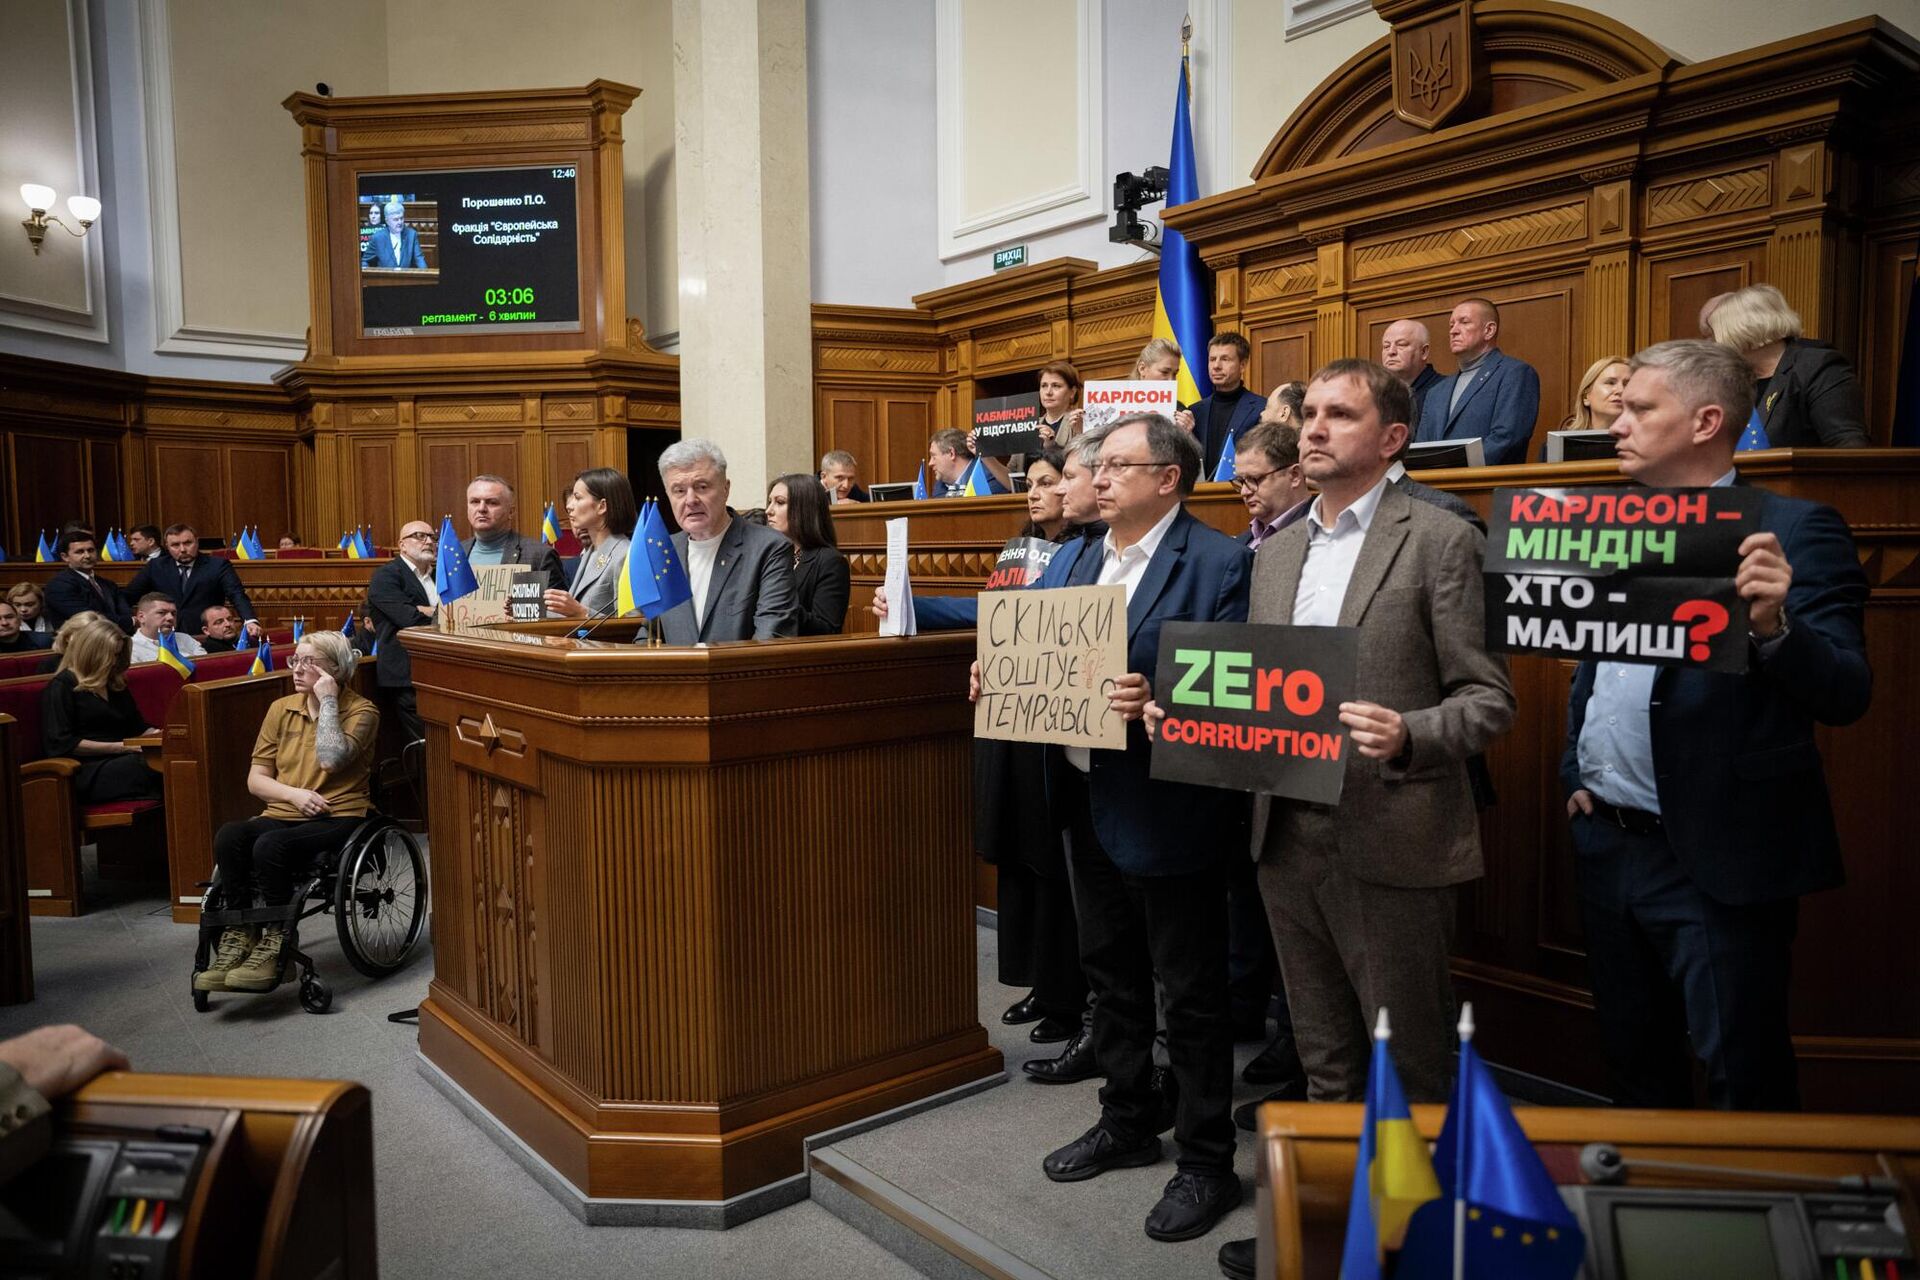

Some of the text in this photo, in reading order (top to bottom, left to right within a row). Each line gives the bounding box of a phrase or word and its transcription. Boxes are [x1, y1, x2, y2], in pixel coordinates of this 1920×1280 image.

[551, 168, 576, 179] 12:40
[461, 194, 547, 209] Порошенко П.О.
[451, 222, 489, 235] Фракція
[473, 232, 541, 246] Солідарність"
[997, 248, 1022, 263] ВИХІД
[485, 287, 535, 306] 03:06
[421, 312, 478, 326] регламент
[488, 310, 496, 322] 6
[498, 310, 536, 322] хвилин
[1087, 390, 1172, 404] КАРЛСОН
[976, 406, 1036, 423] КАБМІНДІЧ
[975, 421, 1038, 437] У ВІДСТАВКУ
[1509, 494, 1708, 524] КАРЛСОН
[997, 547, 1027, 565] ЕННЯ
[1505, 528, 1677, 570] МІНДІЧ
[1504, 574, 1594, 608] ХТО
[989, 596, 1116, 648] СКІЛЬКИ
[1506, 599, 1730, 662] МАЛИШ?
[981, 650, 1079, 691] КОШТУЄ
[1171, 649, 1325, 716] ZEro
[1161, 717, 1342, 761] CORRUPTION
